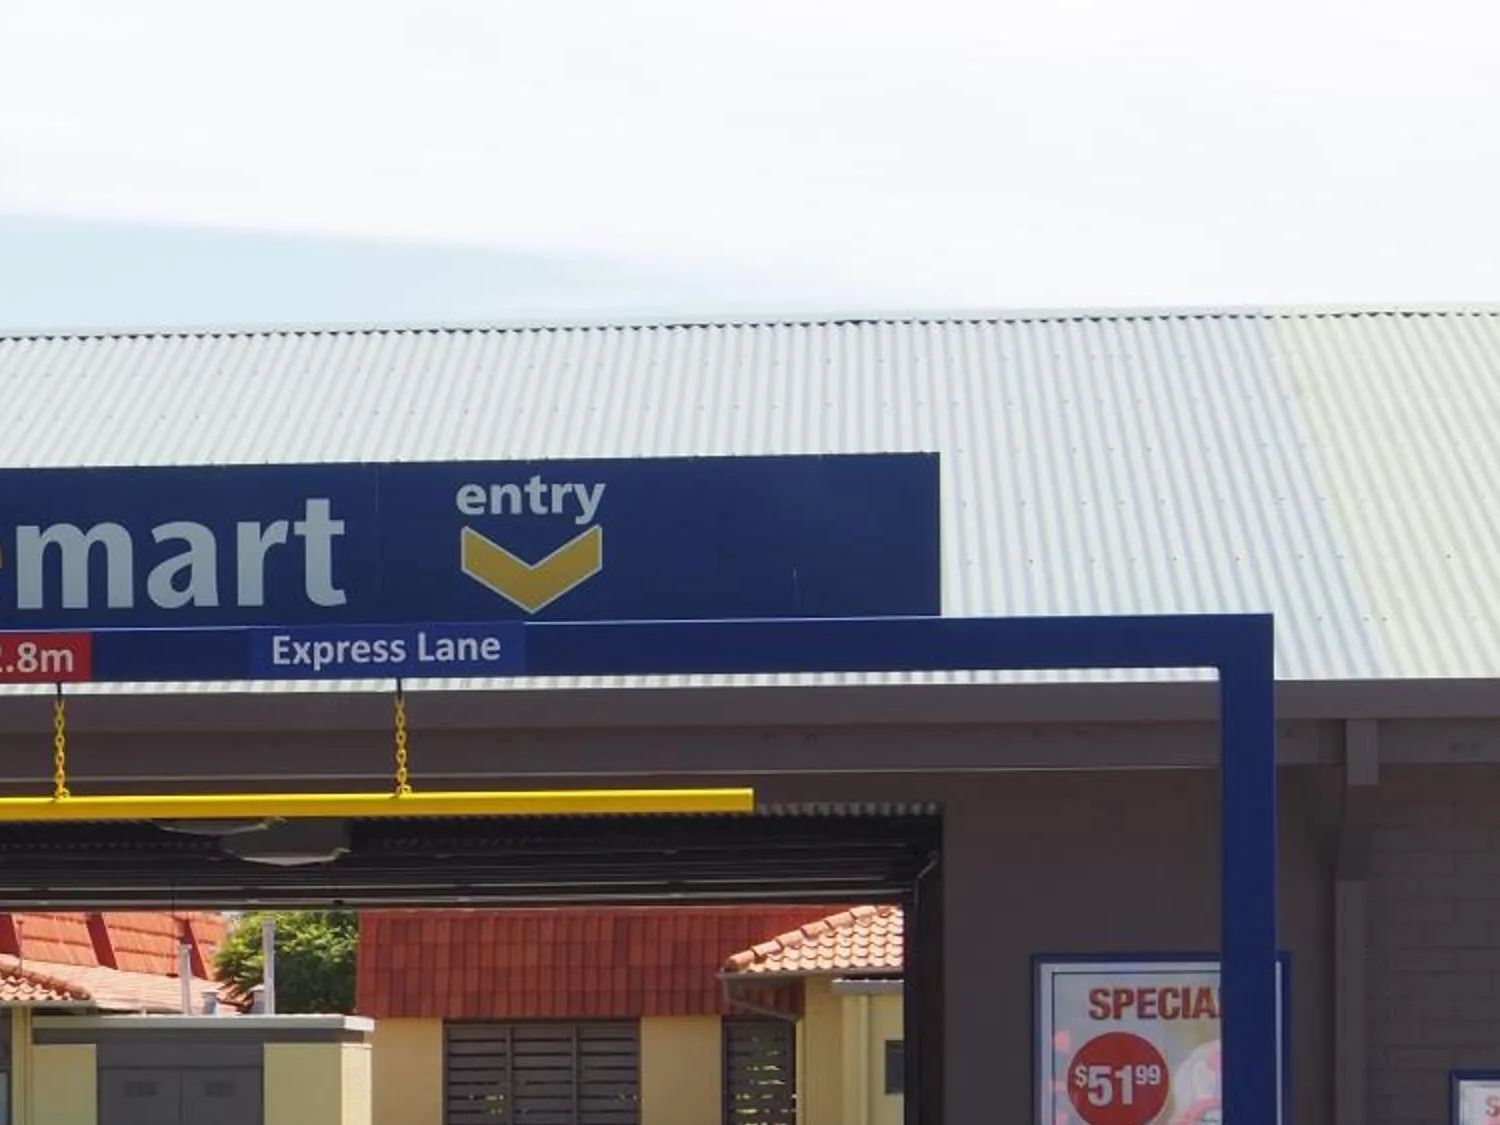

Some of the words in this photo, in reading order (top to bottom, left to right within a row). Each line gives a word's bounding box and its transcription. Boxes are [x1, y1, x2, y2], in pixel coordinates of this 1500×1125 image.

[456, 474, 605, 524] entry
[272, 634, 407, 670] Express
[417, 633, 502, 664] Lane
[1088, 986, 1221, 1021] SPECIA
